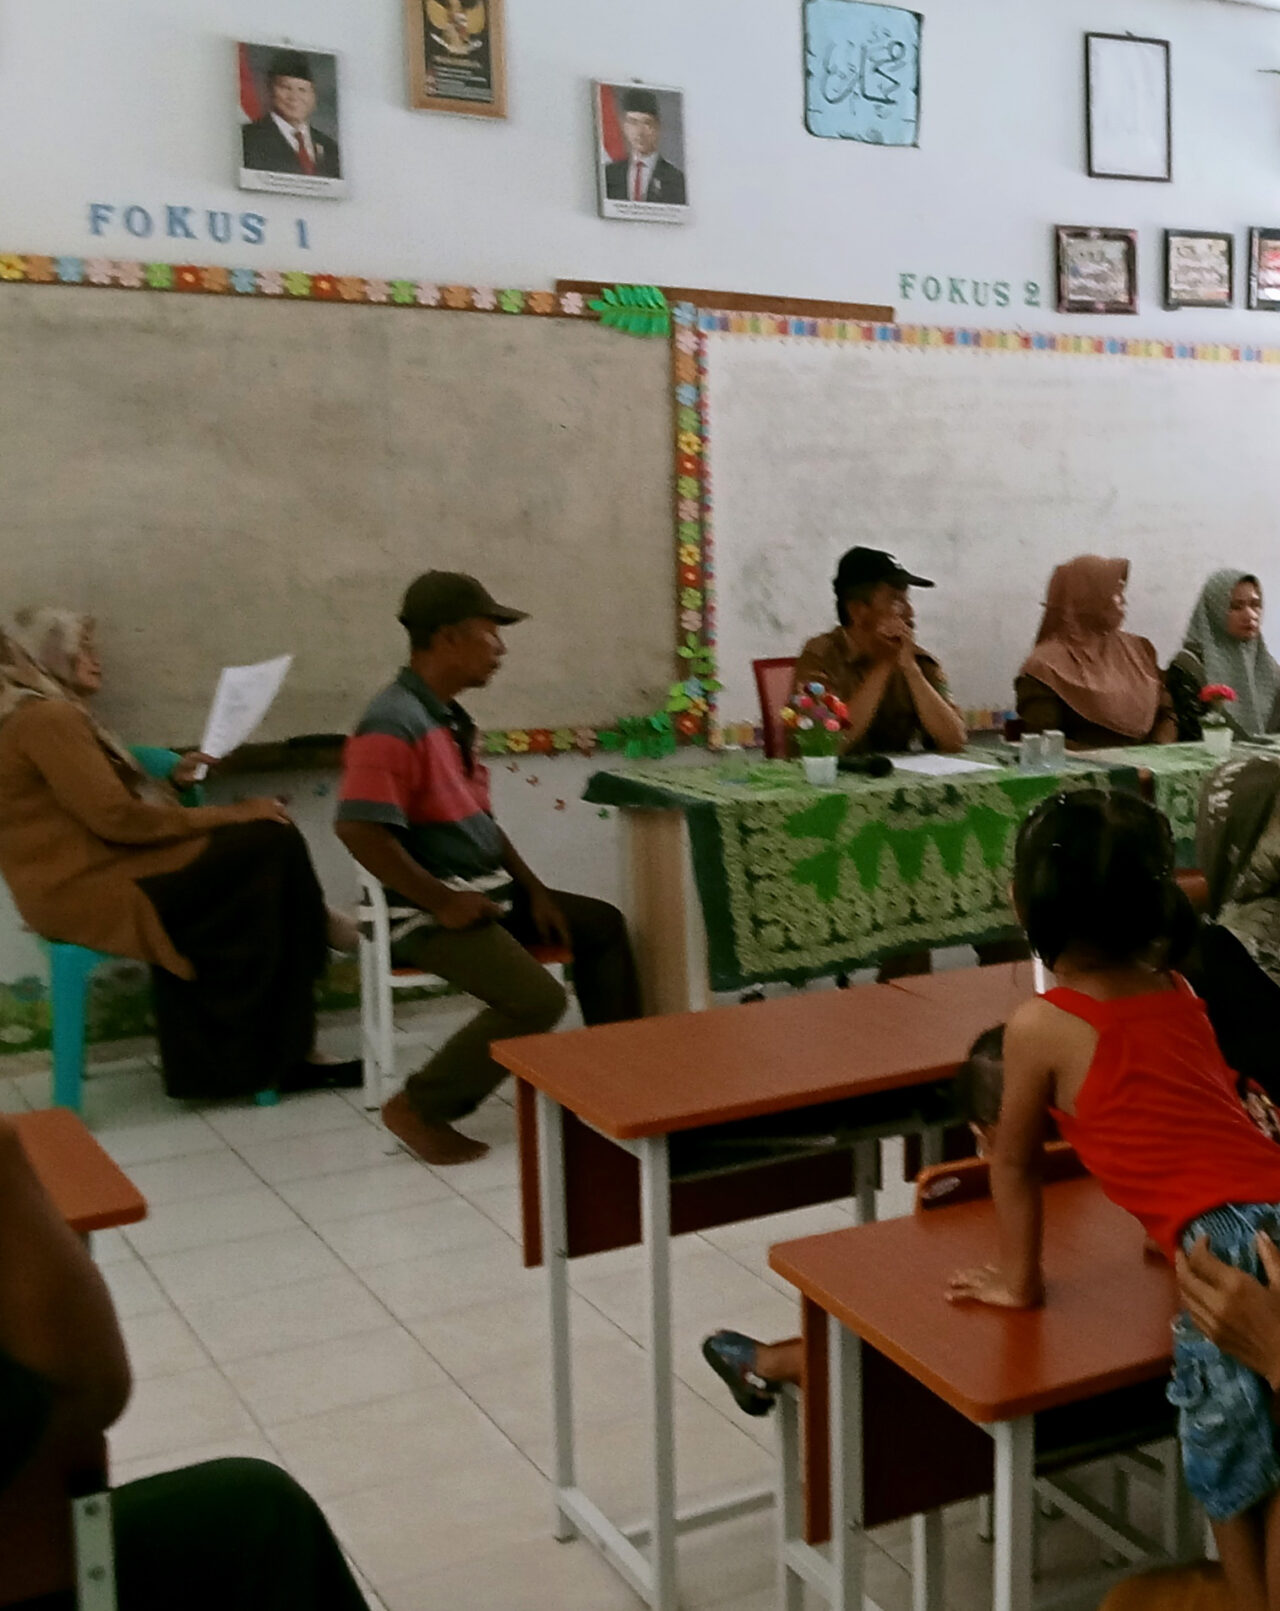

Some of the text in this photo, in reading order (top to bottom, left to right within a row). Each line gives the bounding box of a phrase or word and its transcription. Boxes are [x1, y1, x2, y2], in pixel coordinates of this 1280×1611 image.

[89, 203, 311, 250] FOKUS 1
[898, 272, 1042, 308] FOKUS 2
